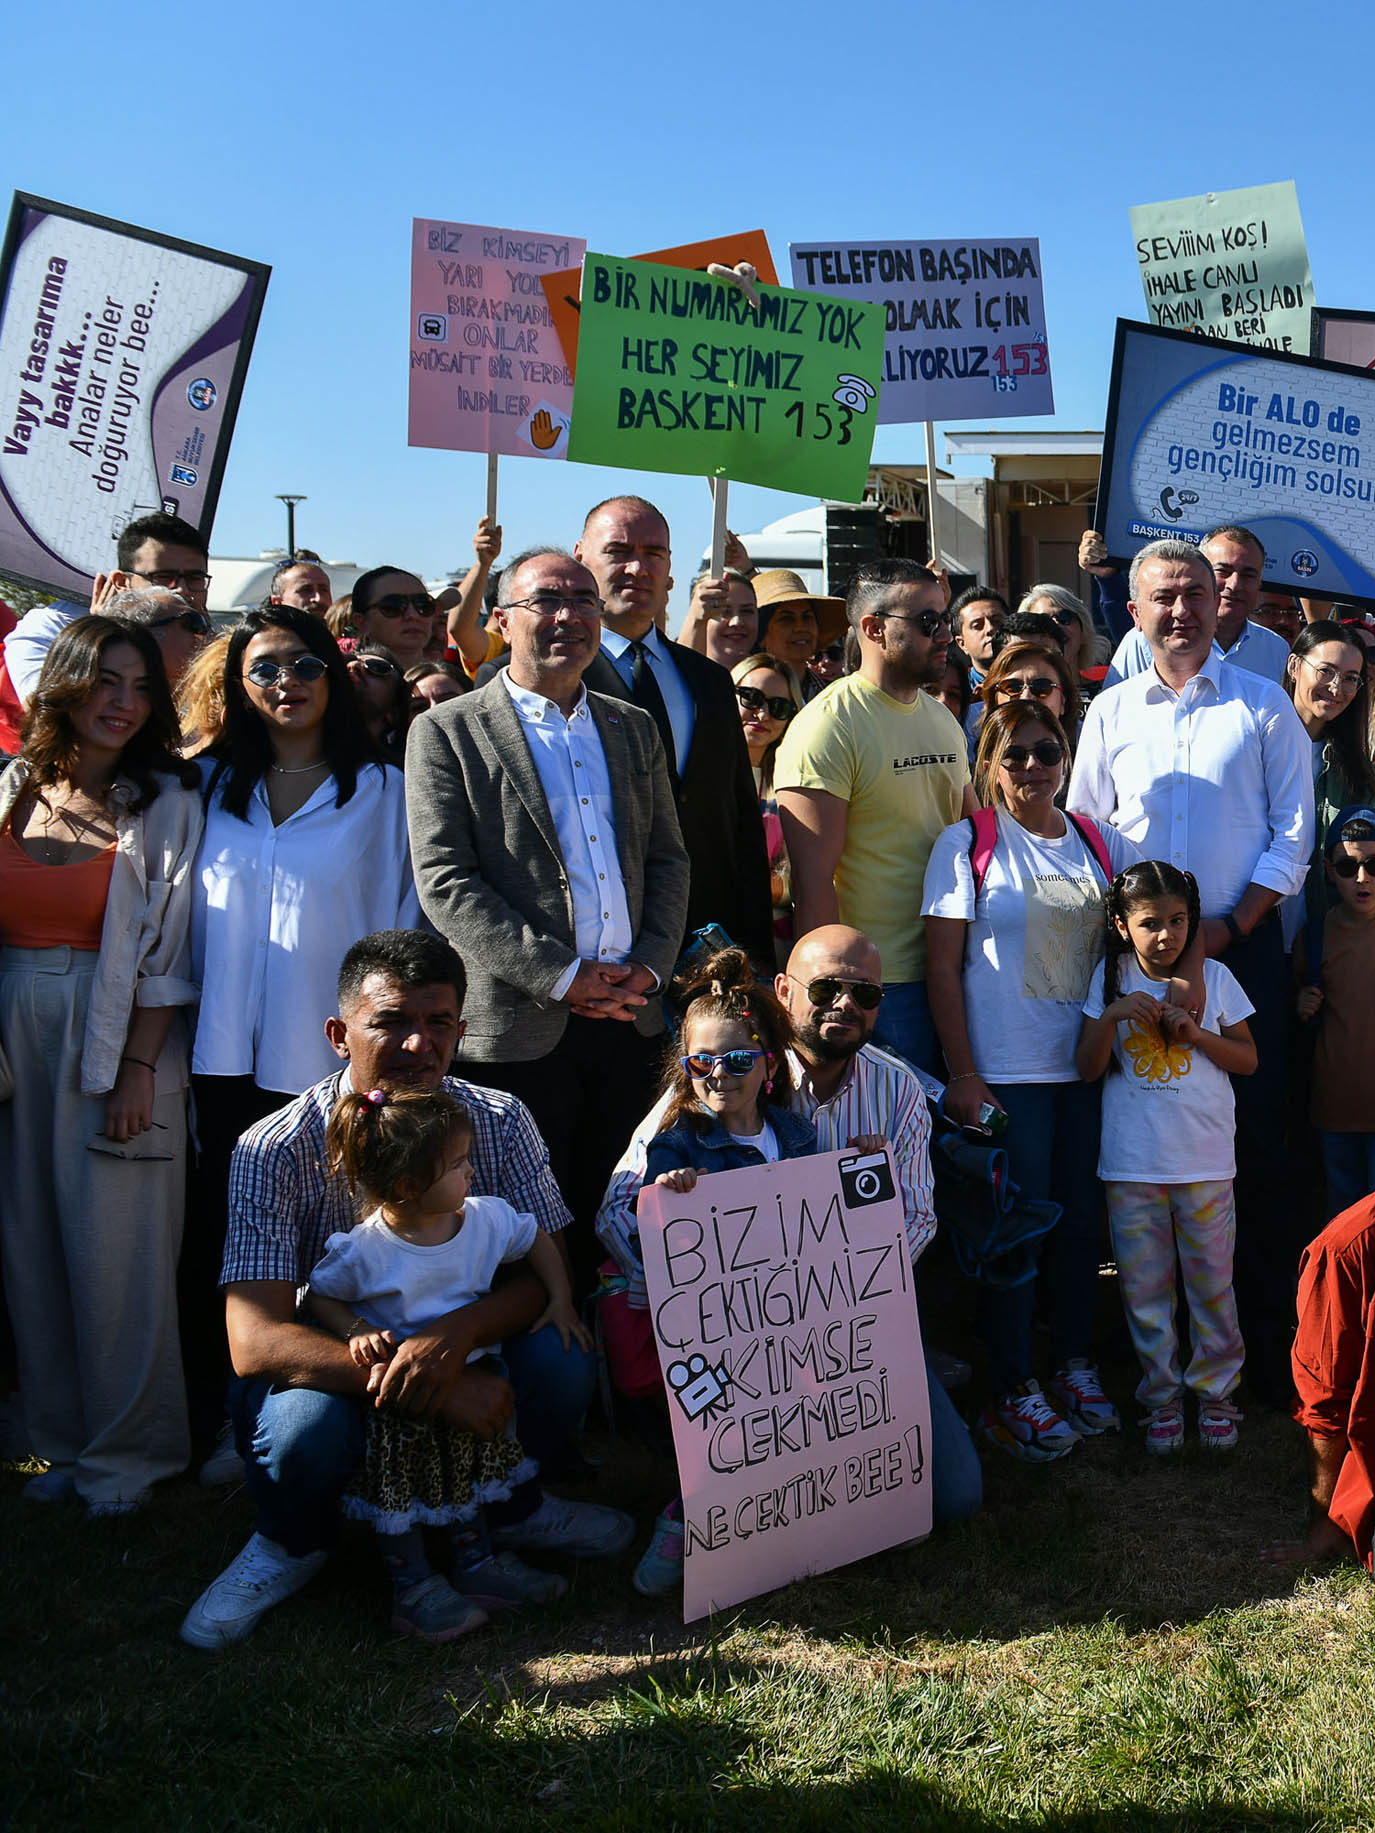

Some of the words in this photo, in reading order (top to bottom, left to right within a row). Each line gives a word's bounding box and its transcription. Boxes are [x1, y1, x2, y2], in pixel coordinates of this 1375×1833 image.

[428, 226, 463, 253] BİZ
[483, 236, 570, 268] KİMSEYİ
[796, 248, 916, 286] TELEFON
[919, 248, 1038, 286] BAŞINDA
[437, 259, 484, 289] YARI
[1143, 269, 1198, 298] İHALE
[1203, 260, 1260, 290] CANLI
[20, 256, 69, 384] tasarıma
[447, 295, 557, 328] BIRAKMADI
[593, 265, 642, 311] BİR
[650, 276, 809, 335] NUMARAMIZ
[815, 301, 866, 351] YOK
[884, 297, 963, 333] OLMAK
[975, 291, 1031, 333] İÇİN
[1151, 298, 1206, 327] YAYINI
[1221, 283, 1304, 318] BAŞLADI
[1234, 313, 1267, 339] BERİ
[463, 322, 540, 354] ONLAR
[620, 336, 679, 377] HER
[44, 311, 93, 430] bakkk...
[69, 369, 109, 458] Analar
[94, 295, 125, 366] neler
[410, 348, 482, 375] MÜSAİT
[488, 354, 514, 380] BİR
[881, 345, 990, 383] LİYORUZ
[991, 342, 1049, 377] 153
[92, 357, 142, 493] doğuruyor
[120, 280, 161, 353] bee...
[457, 385, 531, 418] İNDİLER
[4, 388, 45, 456] Vayy
[784, 400, 854, 446] 153
[1217, 382, 1260, 418] Bir
[1266, 392, 1322, 430] ALO
[1327, 403, 1362, 437] de
[1212, 419, 1362, 469] gelmezsem
[1167, 443, 1297, 490] gençliğim
[1131, 523, 1183, 541] BAŞKENT
[1183, 532, 1201, 544] 153
[893, 753, 957, 769] LACOSTE
[662, 1193, 851, 1288] BİZİM
[656, 1232, 907, 1353] ÇEKTİĞİMİZİ
[722, 1314, 878, 1408] KİMSE
[685, 1505, 731, 1557] NE
[734, 1464, 838, 1540] ÇEKTİK
